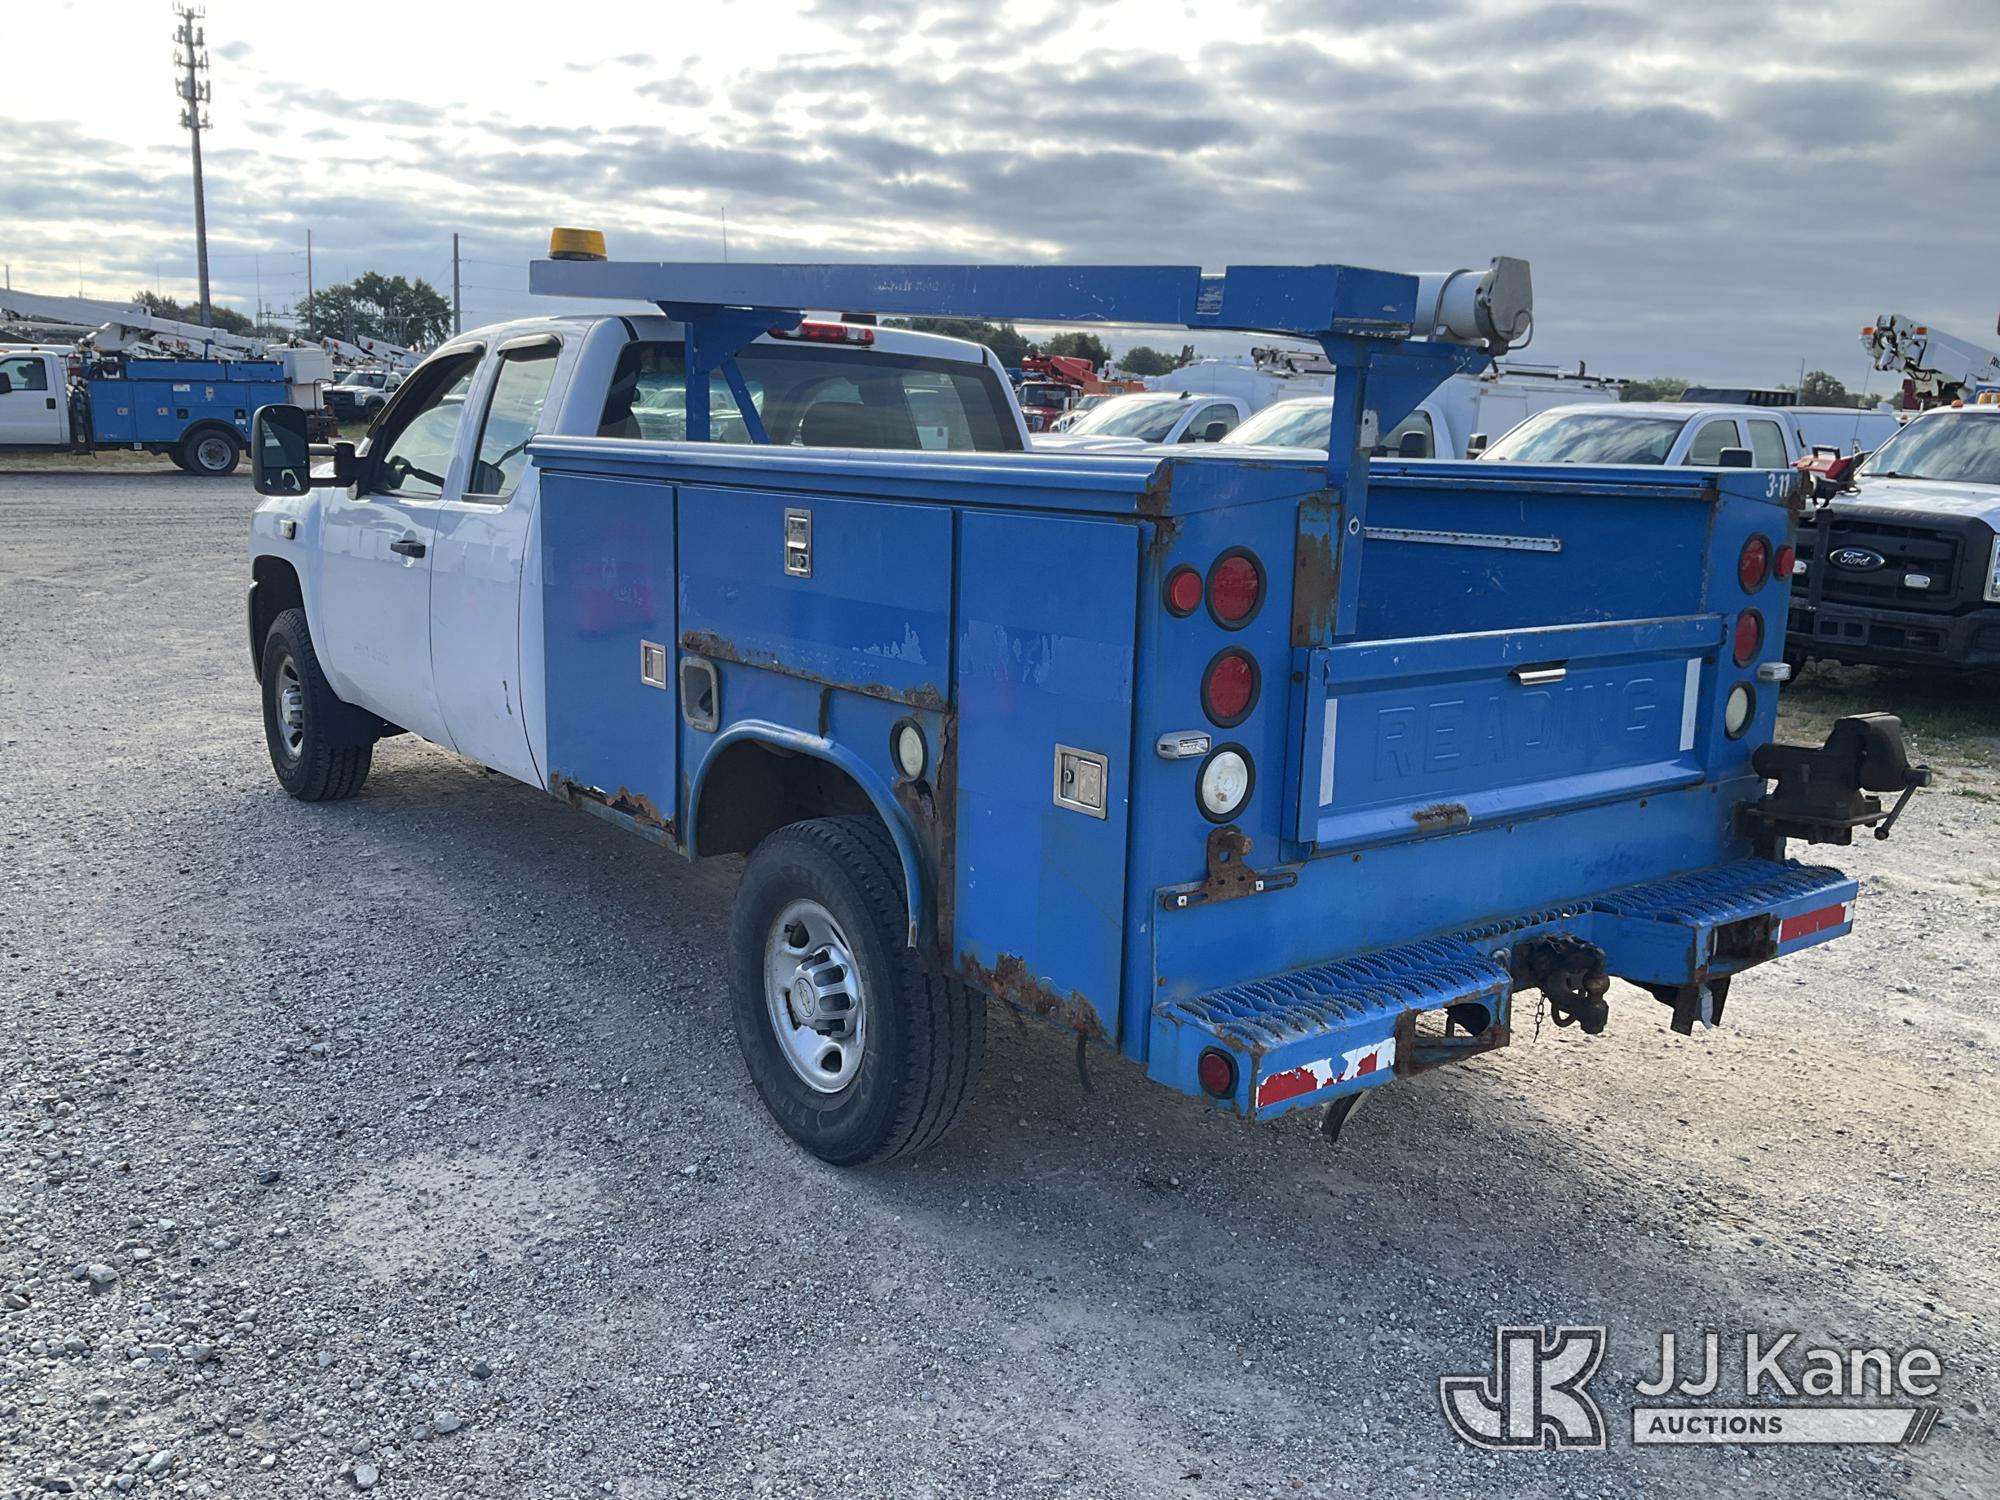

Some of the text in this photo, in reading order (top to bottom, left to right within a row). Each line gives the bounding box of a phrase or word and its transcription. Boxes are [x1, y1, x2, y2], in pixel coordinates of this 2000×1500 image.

[1766, 473, 1790, 498] 3-11
[1840, 551, 1871, 566] Ford
[1374, 678, 1656, 782] READING
